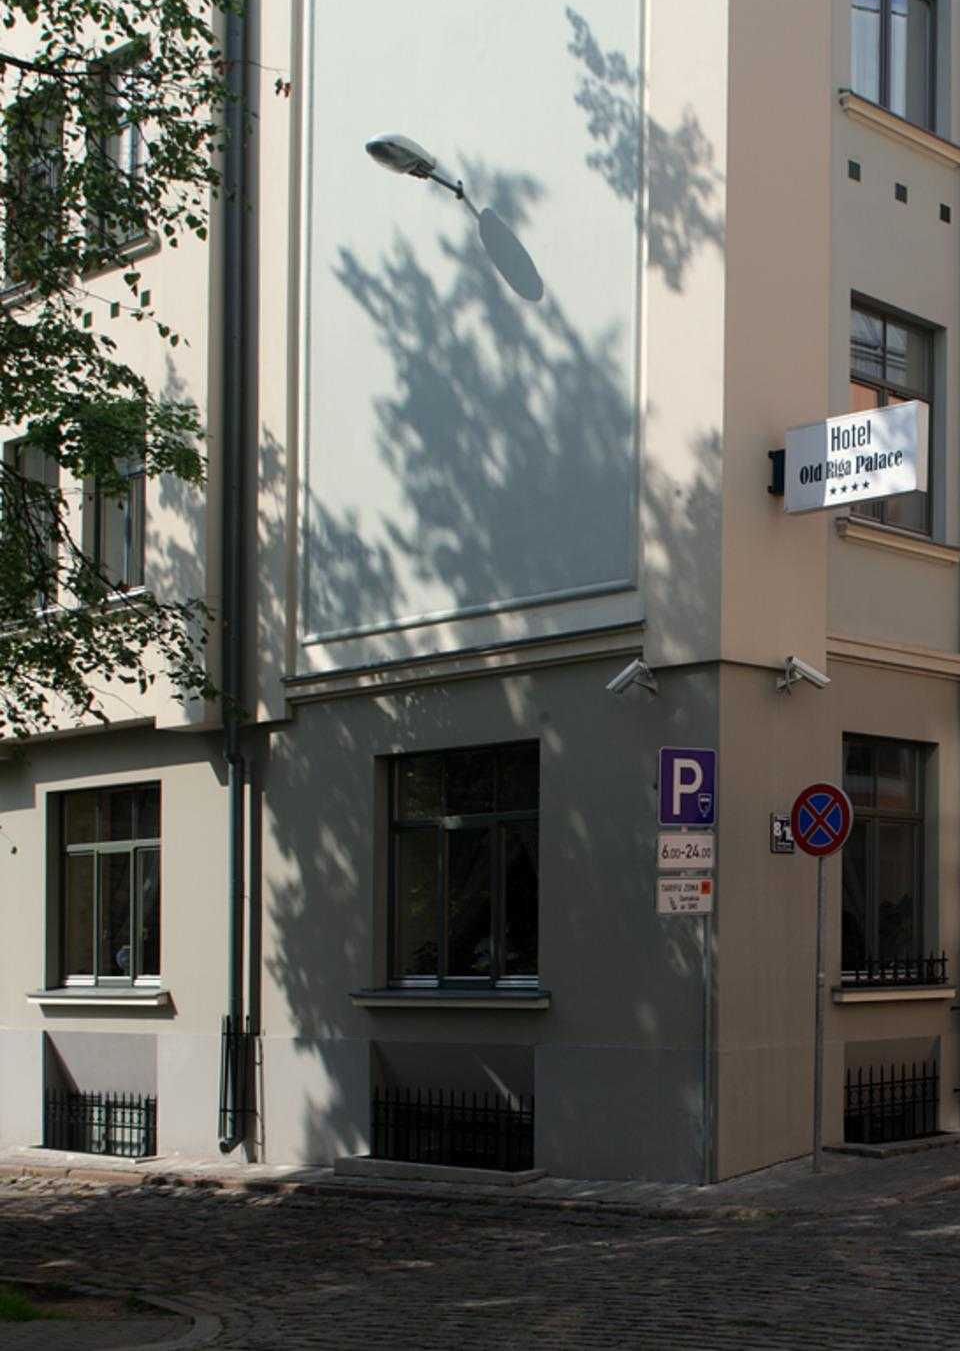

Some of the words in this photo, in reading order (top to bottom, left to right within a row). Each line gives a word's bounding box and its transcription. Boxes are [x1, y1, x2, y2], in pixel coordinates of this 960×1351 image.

[831, 420, 872, 452] Hotel
[799, 462, 822, 485] Old
[825, 458, 852, 481] Riga
[855, 449, 903, 474] Palace
[672, 757, 703, 816] P
